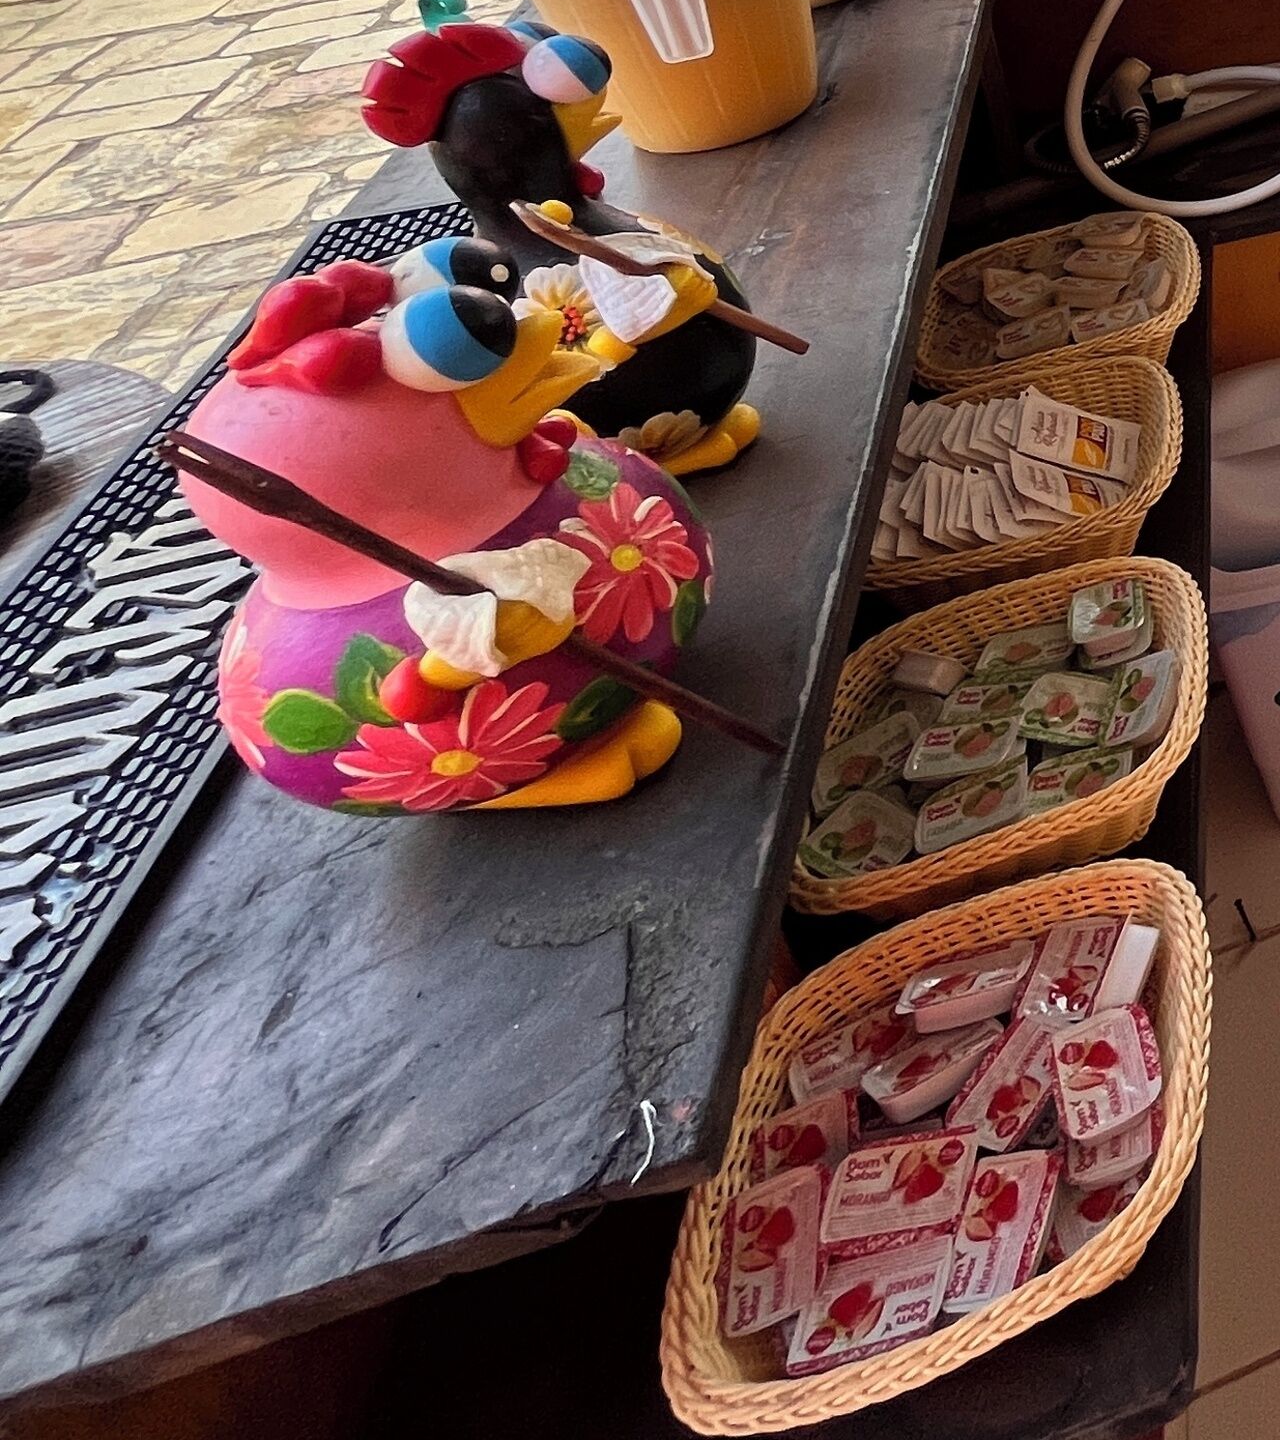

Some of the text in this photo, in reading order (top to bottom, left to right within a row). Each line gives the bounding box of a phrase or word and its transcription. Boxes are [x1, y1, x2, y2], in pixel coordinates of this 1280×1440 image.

[849, 1157, 880, 1170] Bom
[845, 1167, 883, 1182] Sabor
[976, 1236, 1002, 1295] MORANGO
[944, 1263, 968, 1299] Bom
[896, 1309, 929, 1326] Bom
